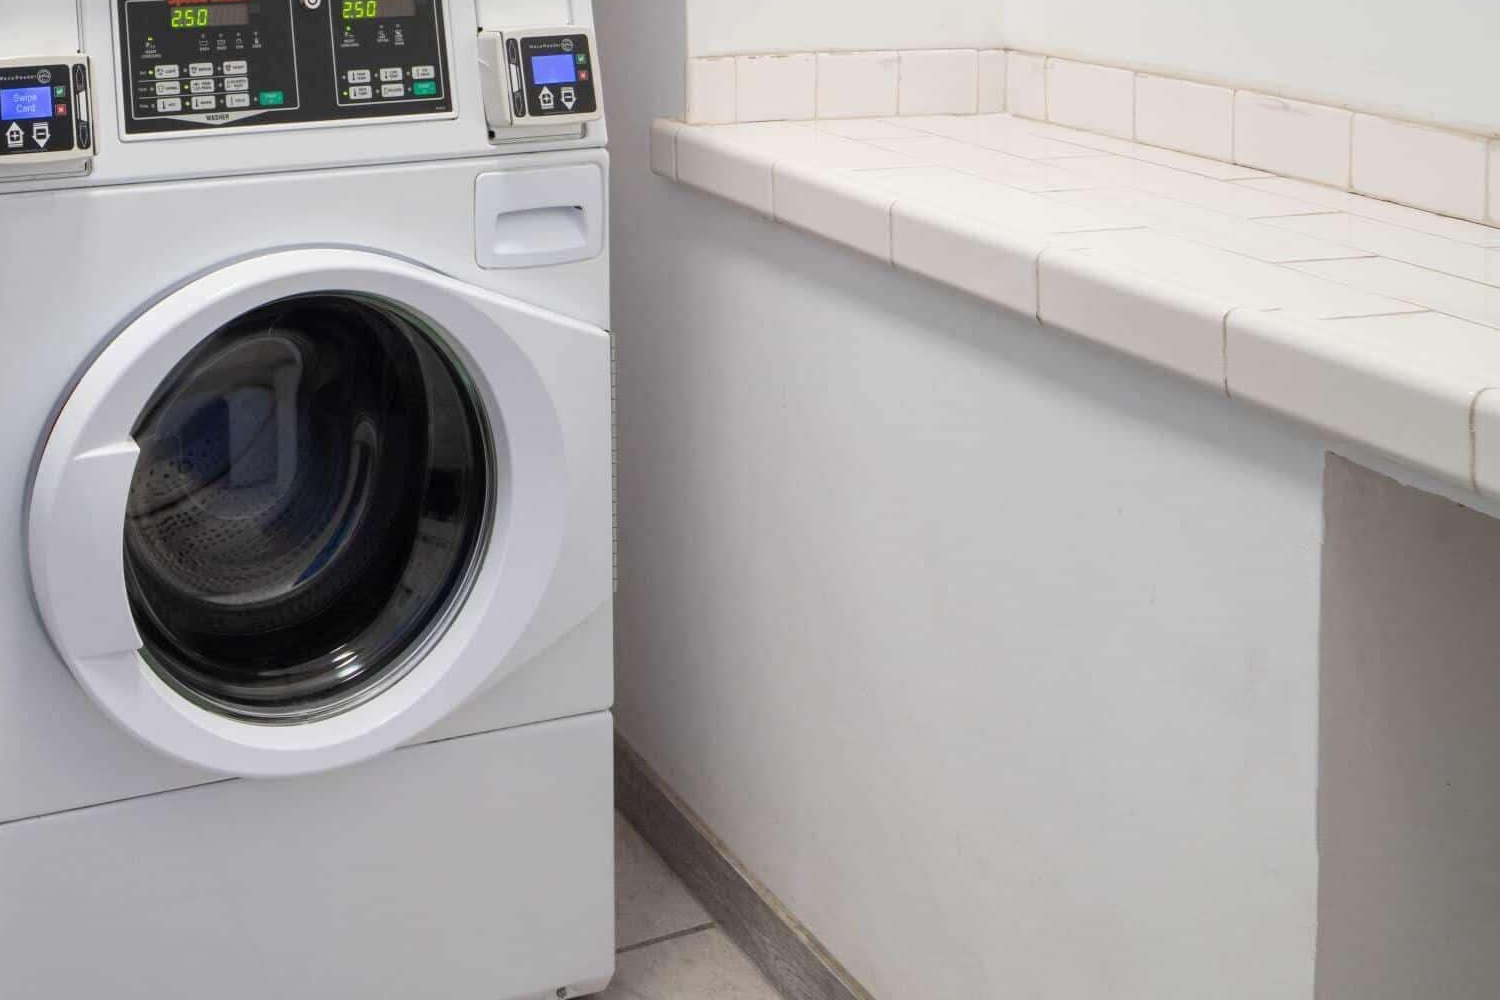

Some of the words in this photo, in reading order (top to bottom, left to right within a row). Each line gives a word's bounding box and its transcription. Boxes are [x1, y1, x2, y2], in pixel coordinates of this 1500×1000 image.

[171, 8, 208, 28] 2.50
[343, 0, 376, 18] 2.50
[16, 104, 36, 113] Card
